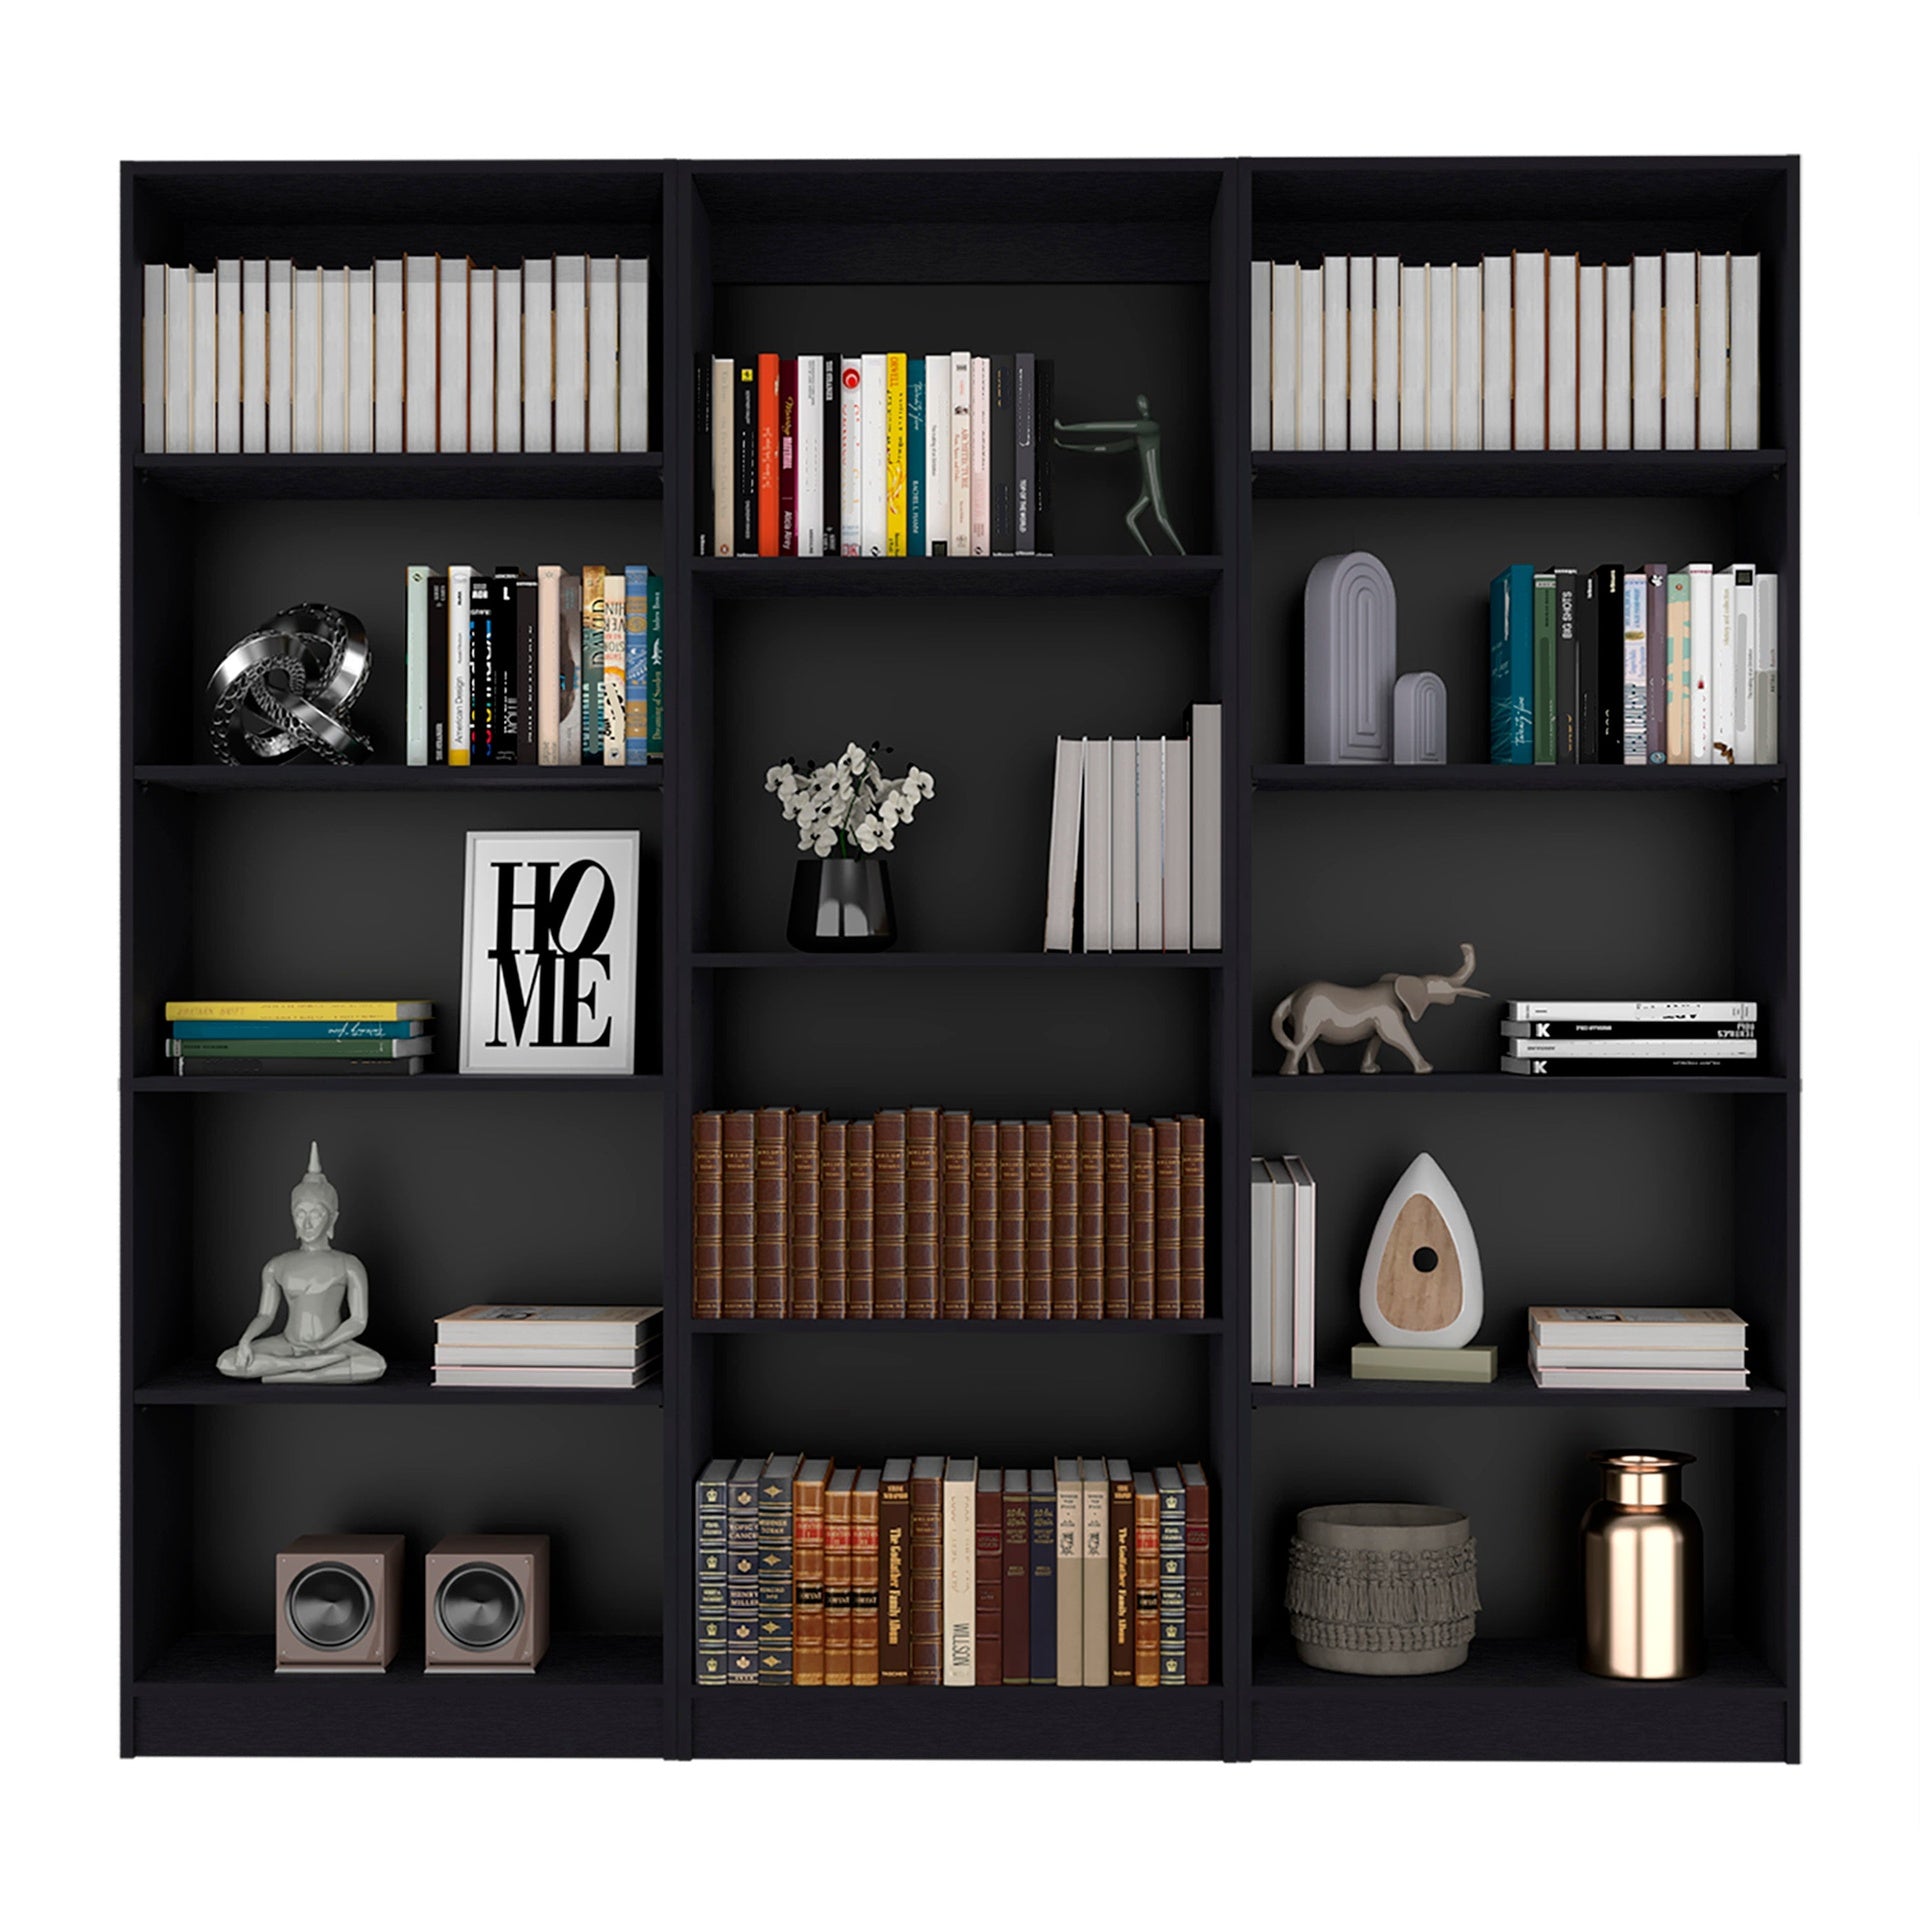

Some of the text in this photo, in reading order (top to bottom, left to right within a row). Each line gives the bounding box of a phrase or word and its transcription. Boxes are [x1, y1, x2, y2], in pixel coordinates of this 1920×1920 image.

[1019, 479, 1027, 491] TOP
[1019, 511, 1027, 533] WORLD
[1562, 591, 1573, 639] BIG SHOTS
[455, 676, 465, 744] American Design
[1536, 1023, 1550, 1037] K
[1533, 1061, 1548, 1074] K
[888, 1527, 901, 1645] The Godfather Family Album
[1117, 1527, 1128, 1644] The Godfather Family Album
[953, 1622, 970, 1667] WILLSON
